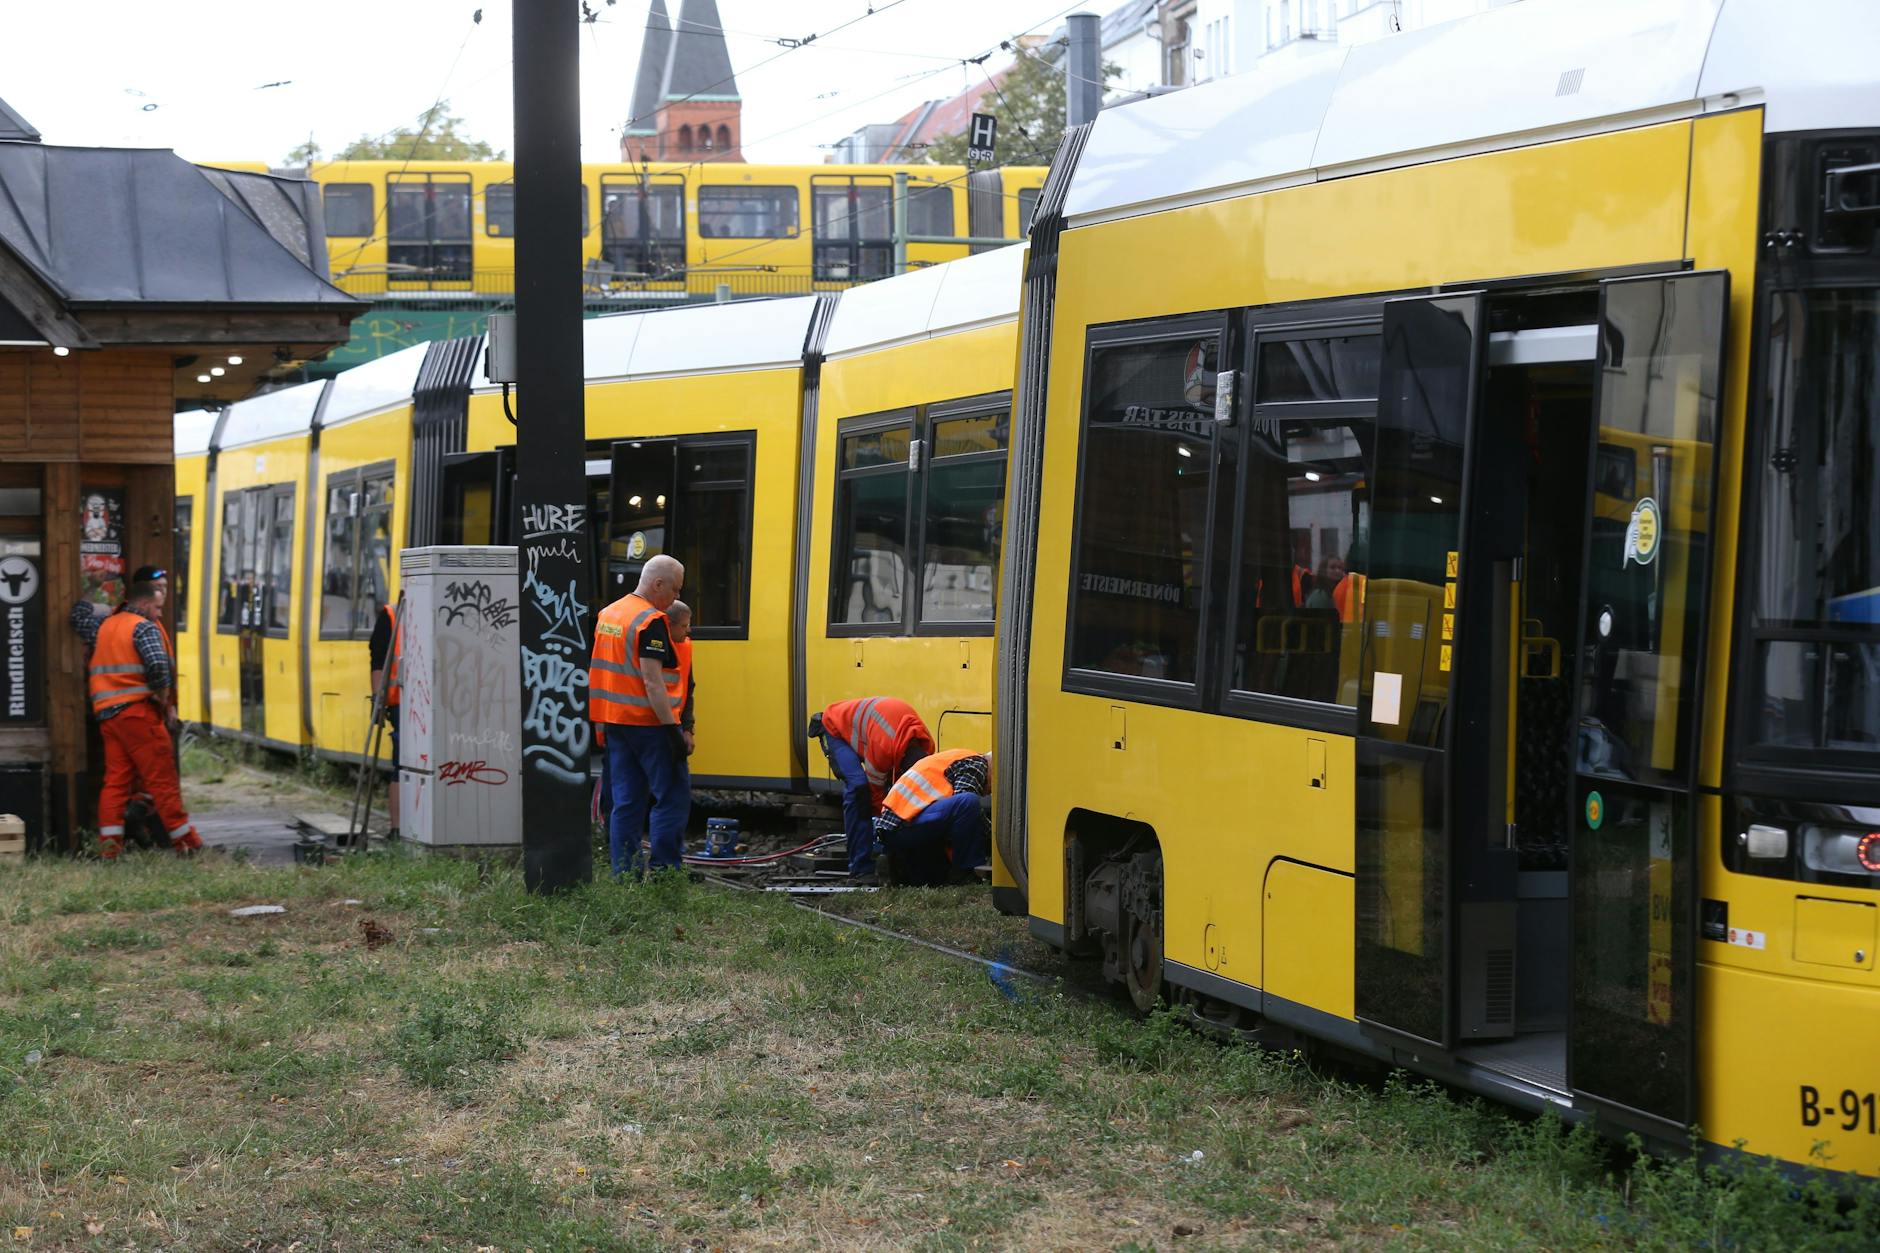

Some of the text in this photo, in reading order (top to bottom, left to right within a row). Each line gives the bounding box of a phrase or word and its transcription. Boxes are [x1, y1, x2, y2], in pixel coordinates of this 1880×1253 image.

[973, 117, 993, 146] H
[522, 503, 587, 532] HURE
[8, 606, 25, 716] Rindfleisch
[1800, 1085, 1880, 1134] B-91
